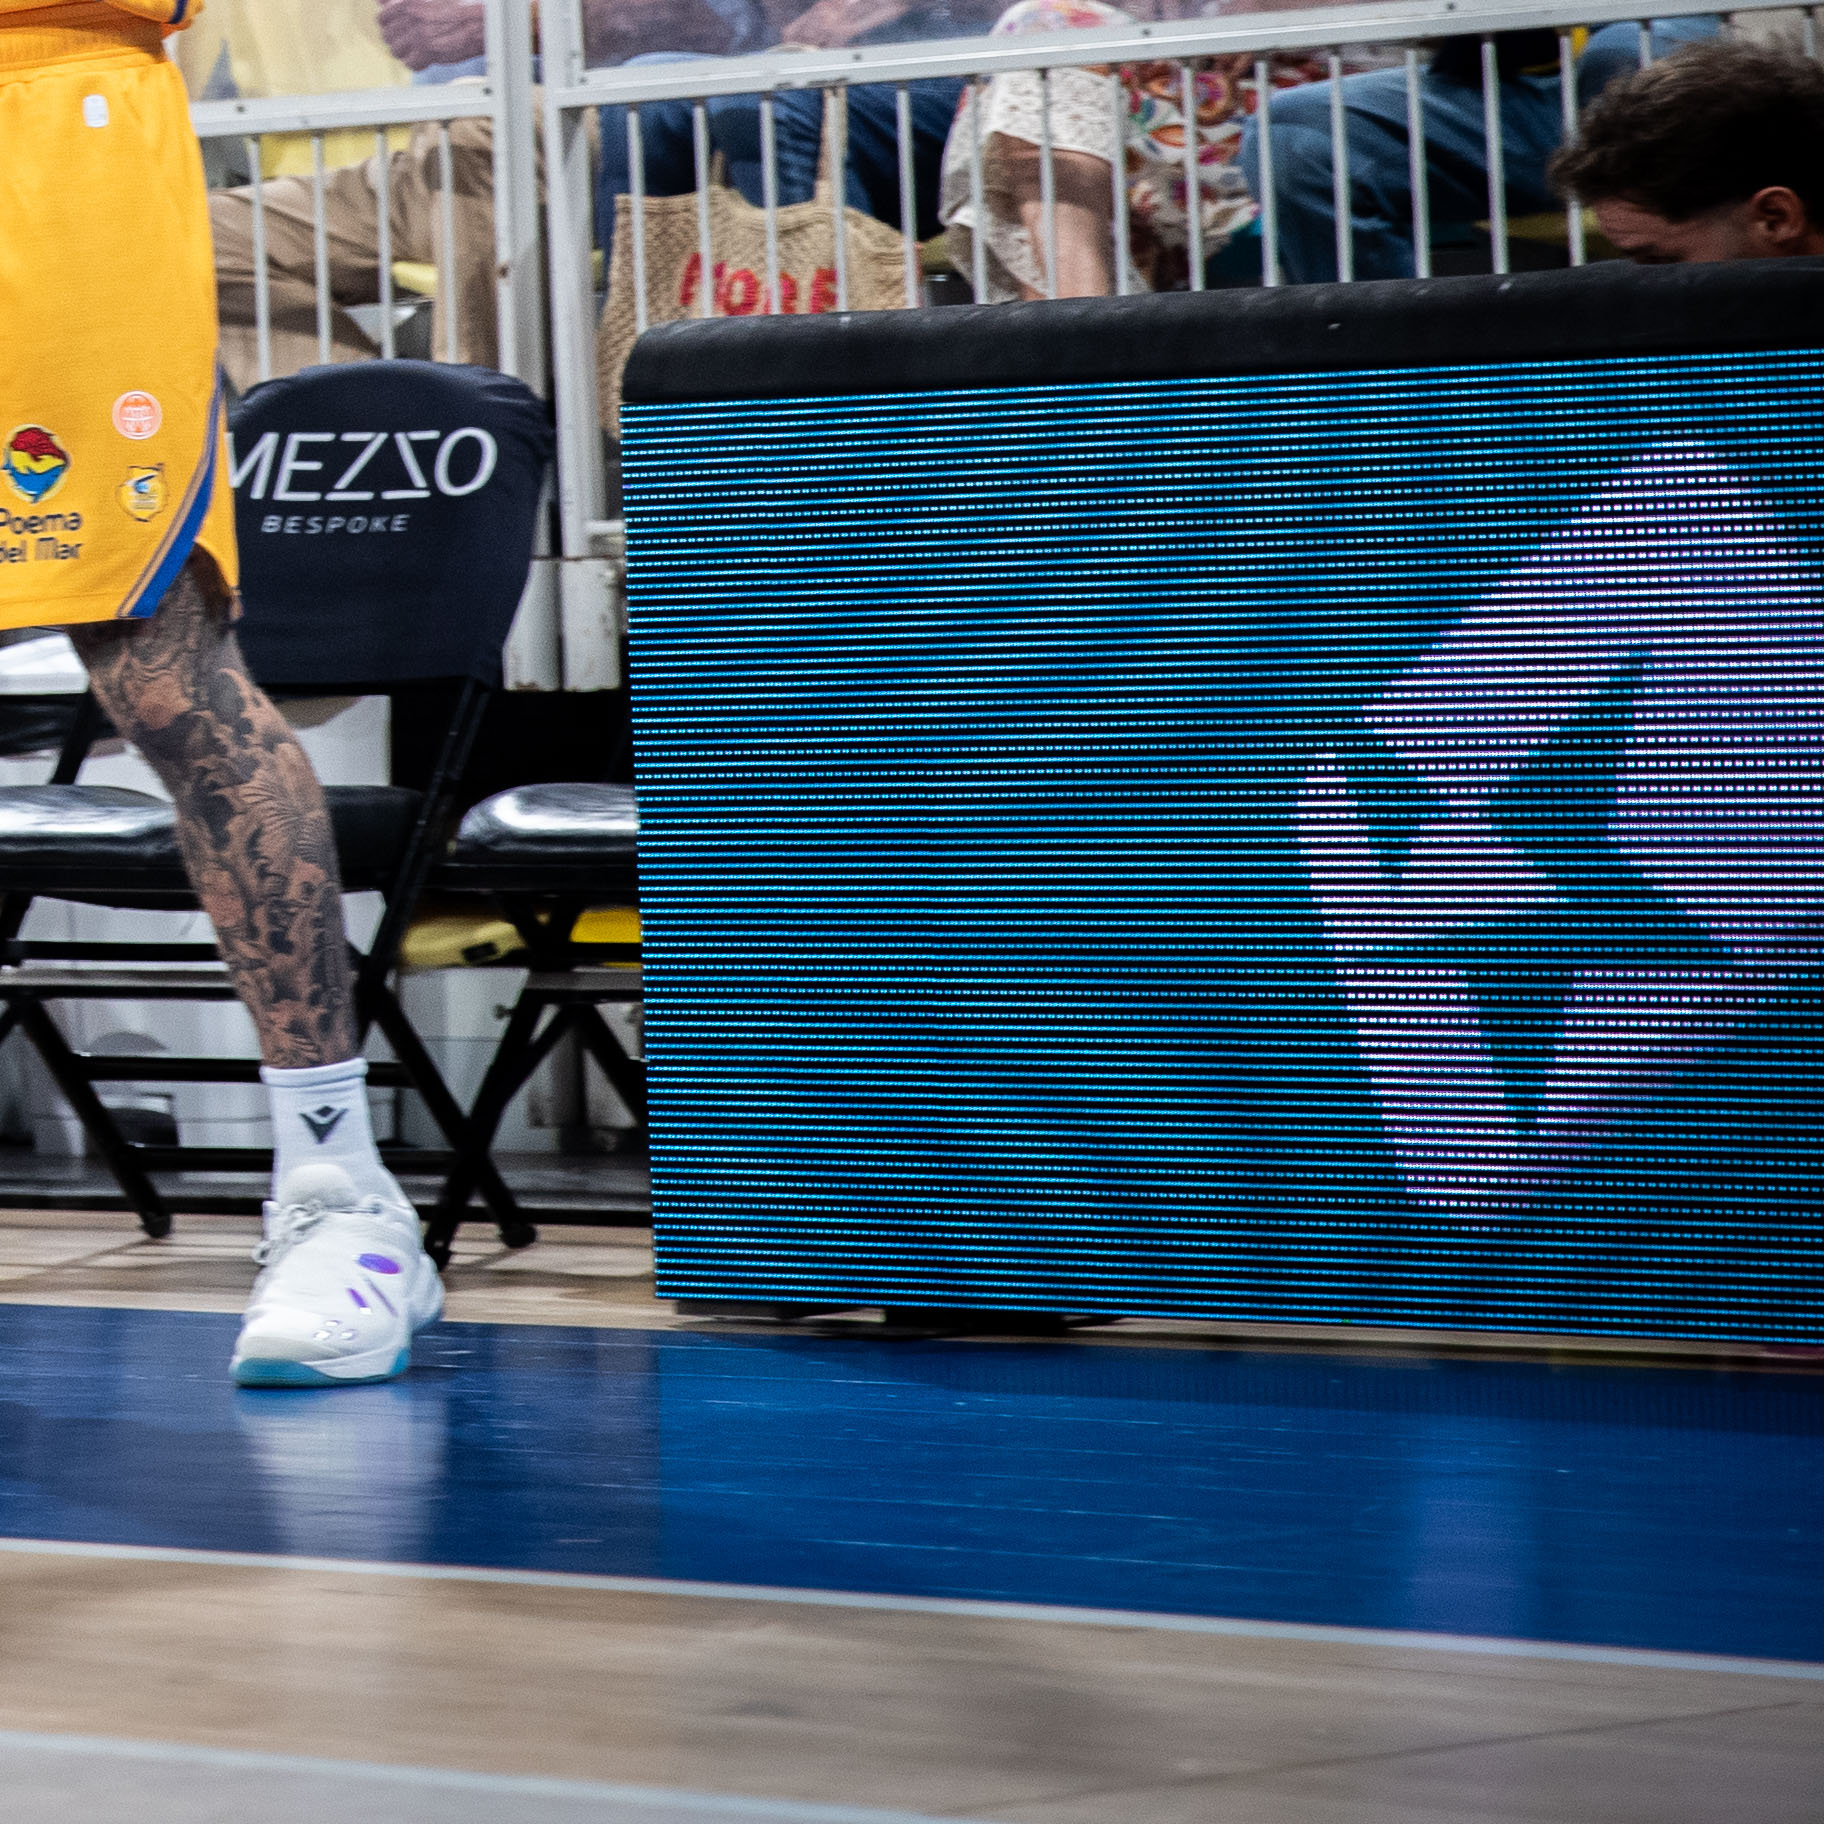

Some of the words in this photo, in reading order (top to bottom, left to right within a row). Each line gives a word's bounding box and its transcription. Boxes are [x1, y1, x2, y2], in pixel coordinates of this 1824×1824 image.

[225, 426, 498, 501] MEZZO
[260, 513, 411, 534] BESPOKE
[34, 537, 82, 561] Mar
